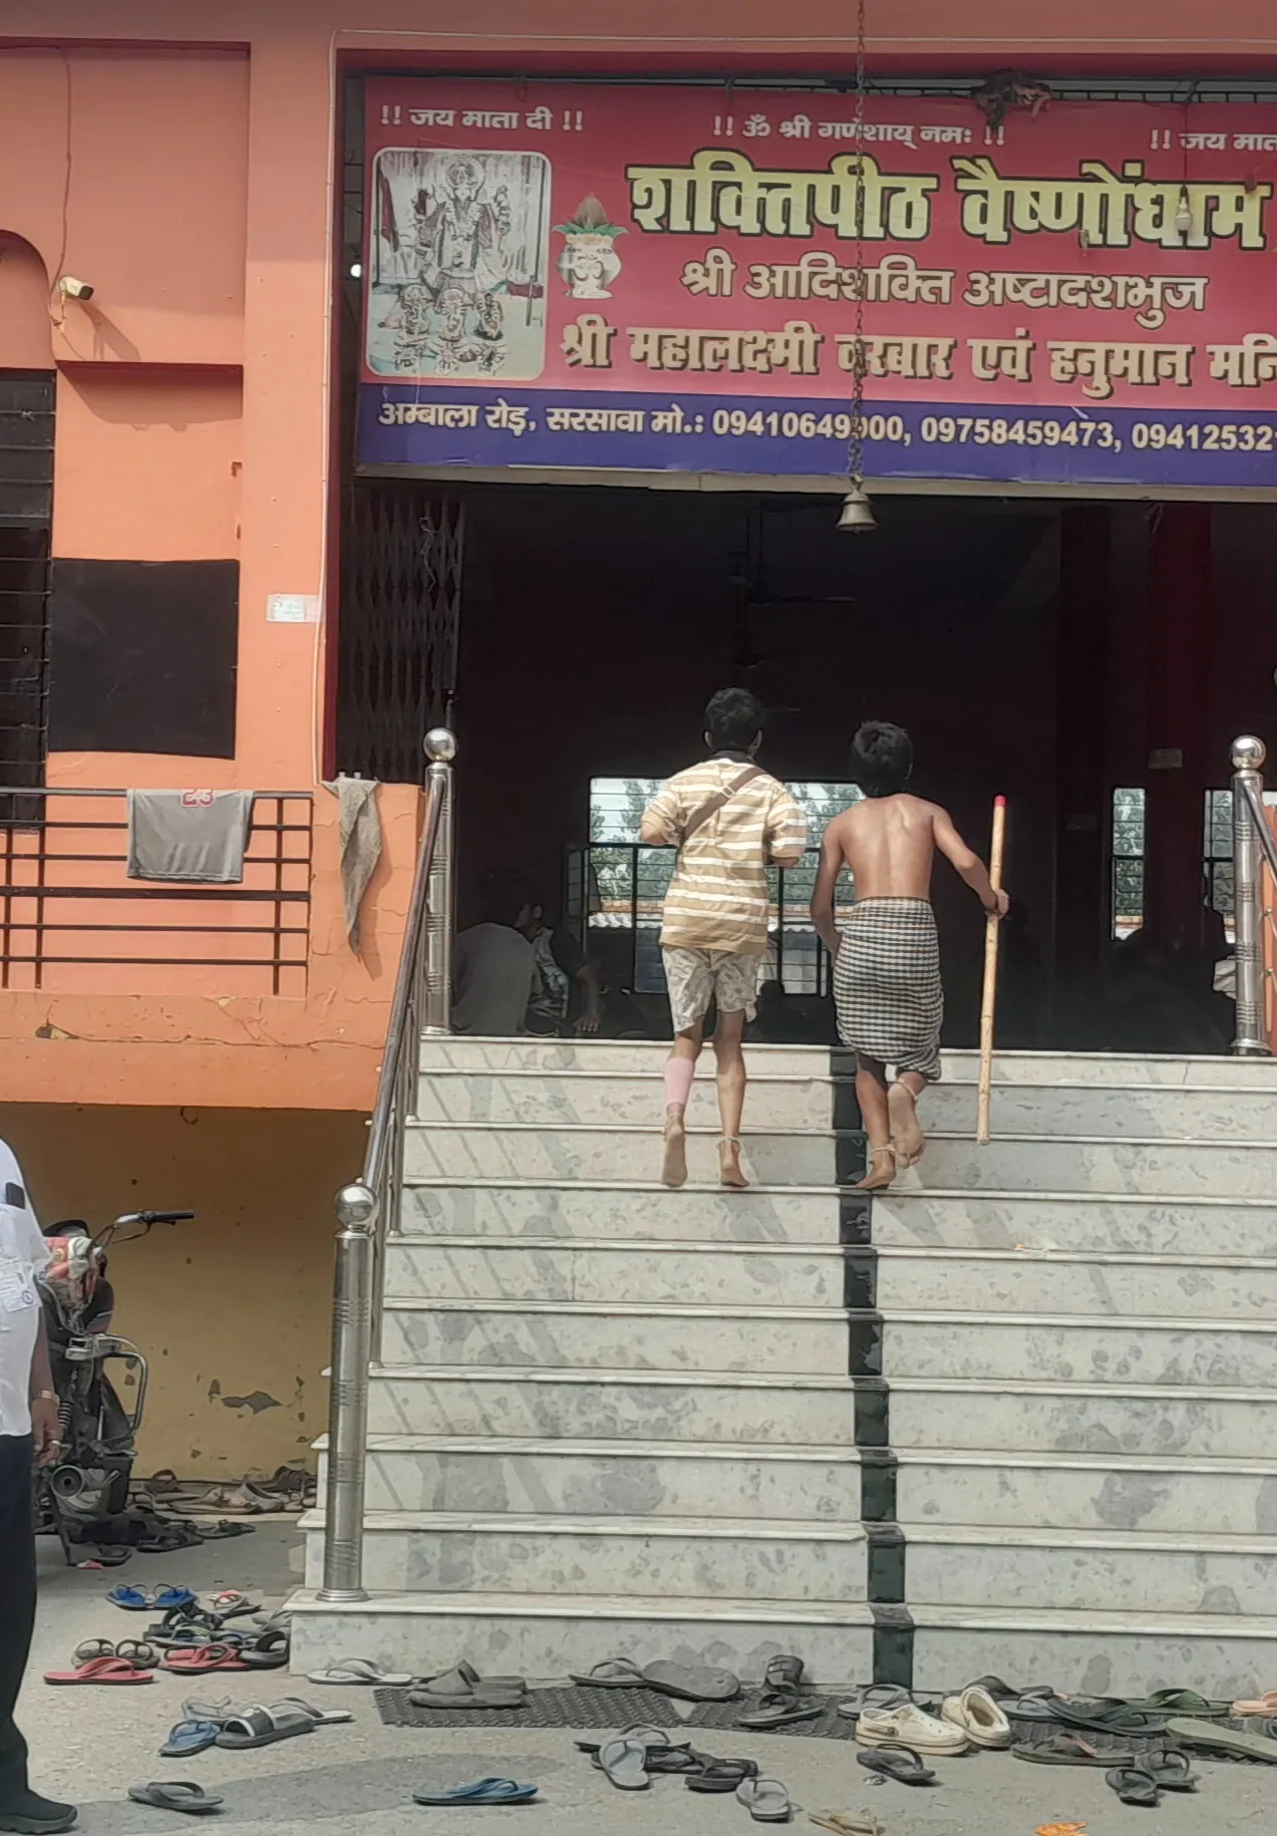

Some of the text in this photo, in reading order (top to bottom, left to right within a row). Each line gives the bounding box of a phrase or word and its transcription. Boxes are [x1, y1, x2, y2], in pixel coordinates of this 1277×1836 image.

[409, 108, 456, 127] जय
[461, 110, 519, 129] माता
[525, 106, 553, 130] दी
[778, 114, 812, 139] श्री
[920, 124, 973, 144] नमः
[1179, 132, 1225, 151] जय
[625, 147, 940, 241] शक्तिपीठ
[680, 246, 1209, 330] श्री आदिशक्ति अष्टादशभुज
[562, 313, 618, 370] श्री
[626, 320, 826, 376] महालक्ष्मी
[966, 327, 1037, 386] एवं
[1047, 341, 1196, 401] हनुमान
[378, 402, 480, 428] अम्बाला
[546, 407, 646, 433] सरसावा
[921, 416, 1122, 454] 09758459473,
